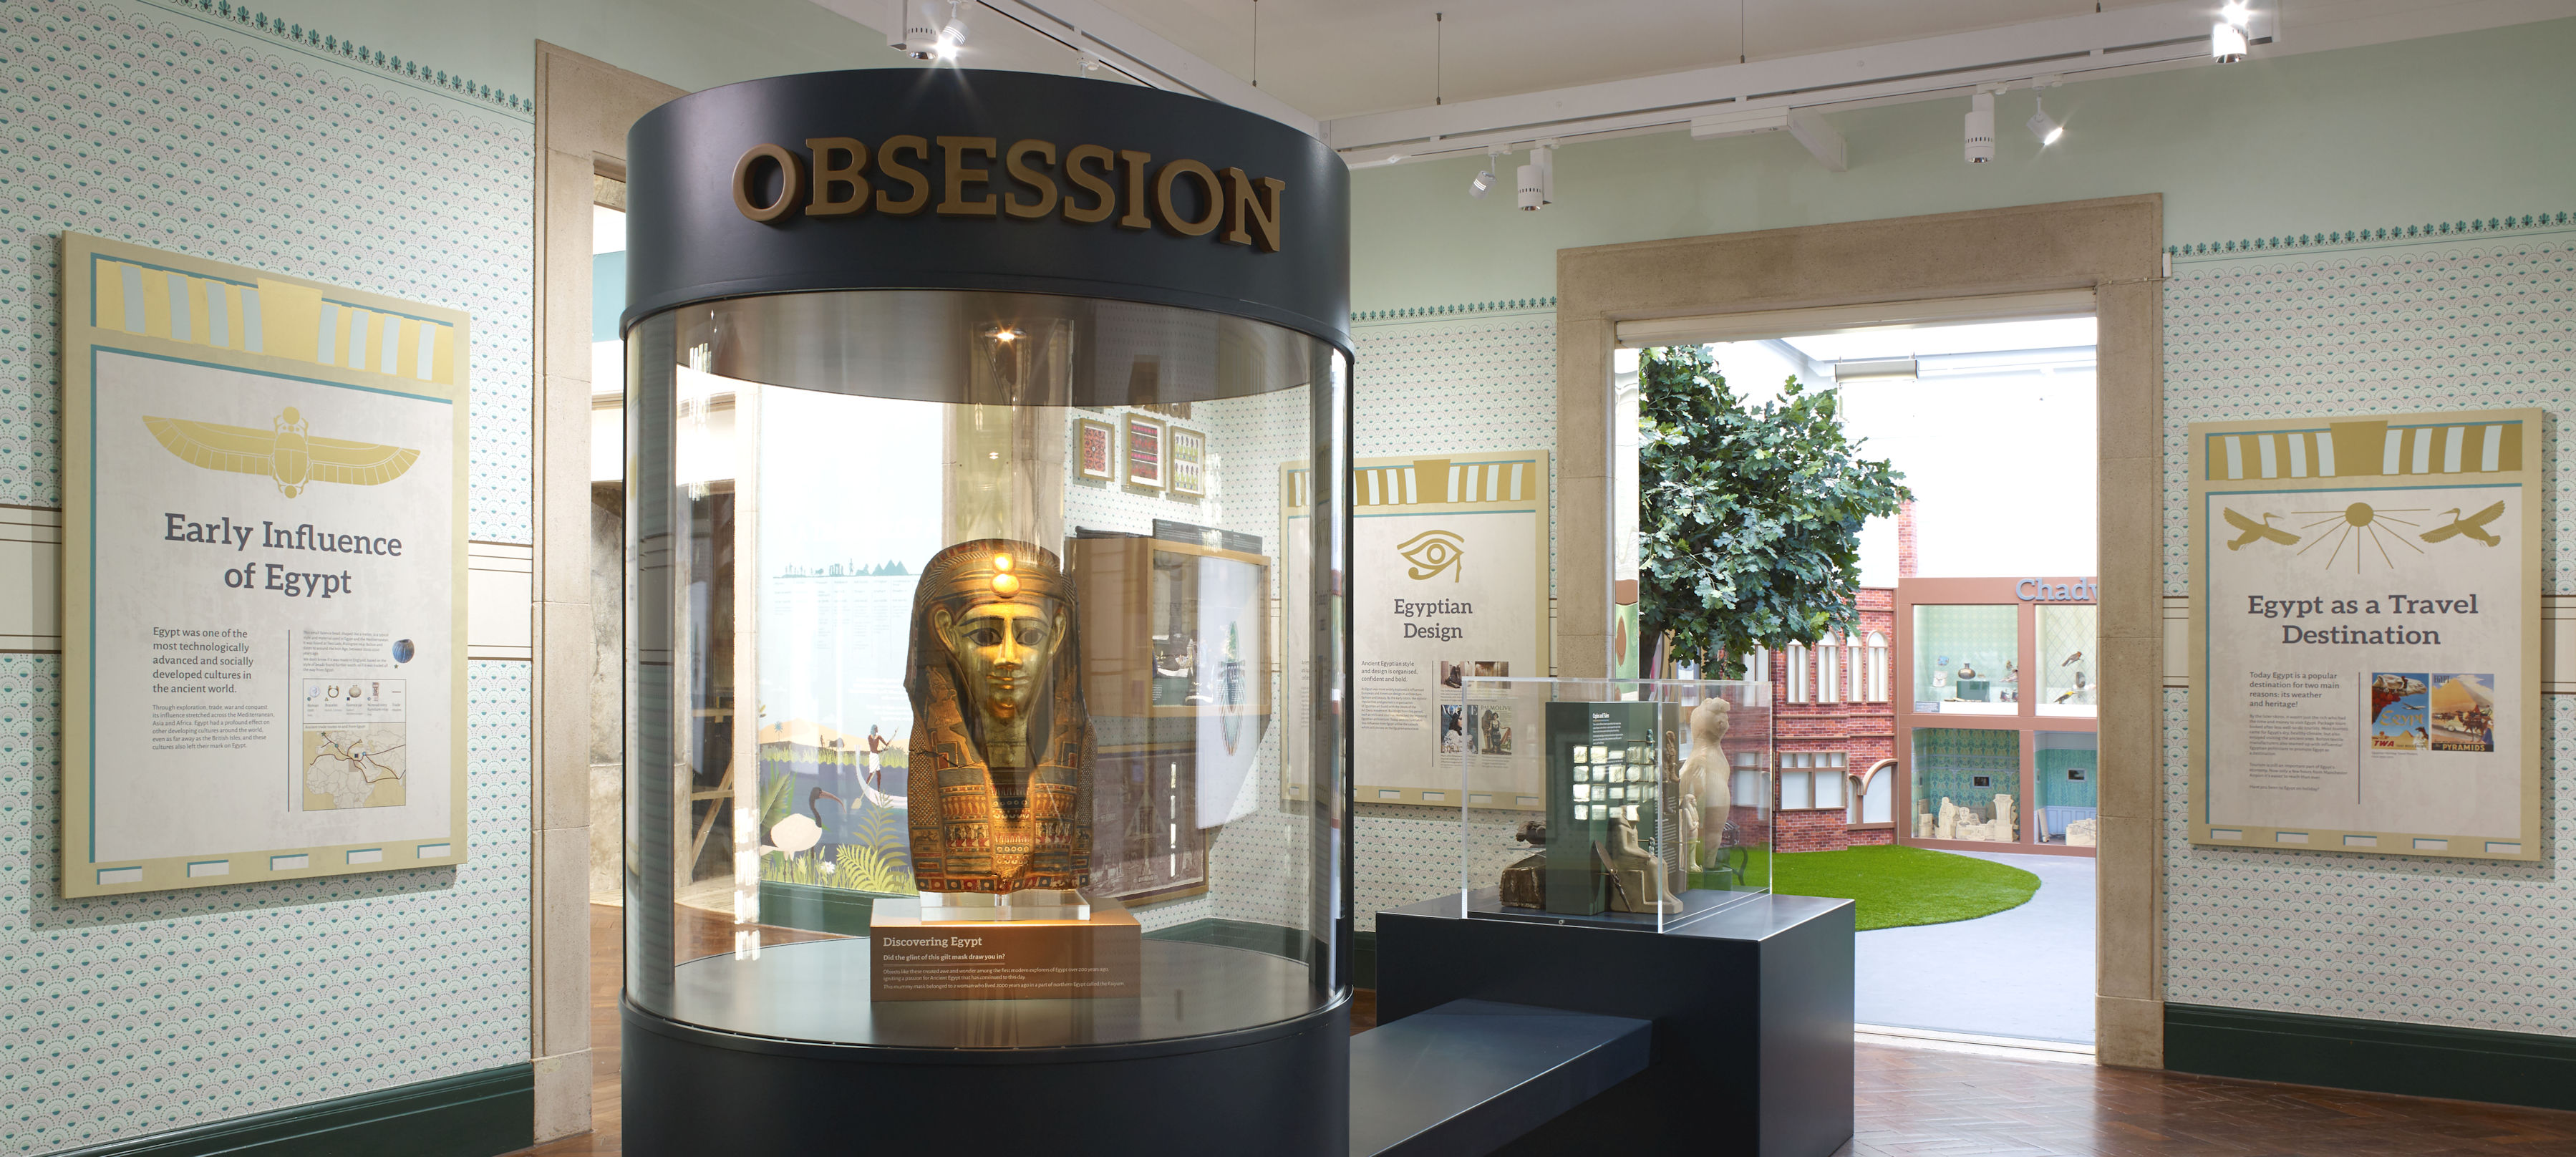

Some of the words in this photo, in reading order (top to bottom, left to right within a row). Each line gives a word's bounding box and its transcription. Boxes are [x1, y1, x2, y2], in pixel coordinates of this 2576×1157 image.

[732, 135, 1285, 252] OBSESSION
[165, 513, 253, 551] Early
[263, 521, 402, 557] Influence
[224, 562, 256, 589] of
[265, 563, 352, 599] Egypt
[1394, 599, 1473, 617] Egyptian
[2248, 594, 2324, 619] Egypt
[2331, 599, 2358, 614] as
[2366, 599, 2381, 614] a
[2388, 594, 2478, 614] Travel
[153, 627, 180, 638] Egypt
[221, 629, 231, 637] of
[232, 629, 248, 637] the
[1404, 623, 1463, 642] Design
[2282, 624, 2441, 644] Destination
[153, 642, 178, 650] most
[179, 642, 249, 654] technologically
[153, 656, 198, 664] advanced
[199, 657, 218, 665] and
[219, 657, 253, 667] socially
[153, 670, 202, 681] developed
[203, 670, 241, 679] cultures
[1441, 705, 1478, 715] VOGE
[2380, 710, 2424, 726] Egypt
[883, 936, 949, 949] Discovering
[950, 936, 982, 948] Egypt
